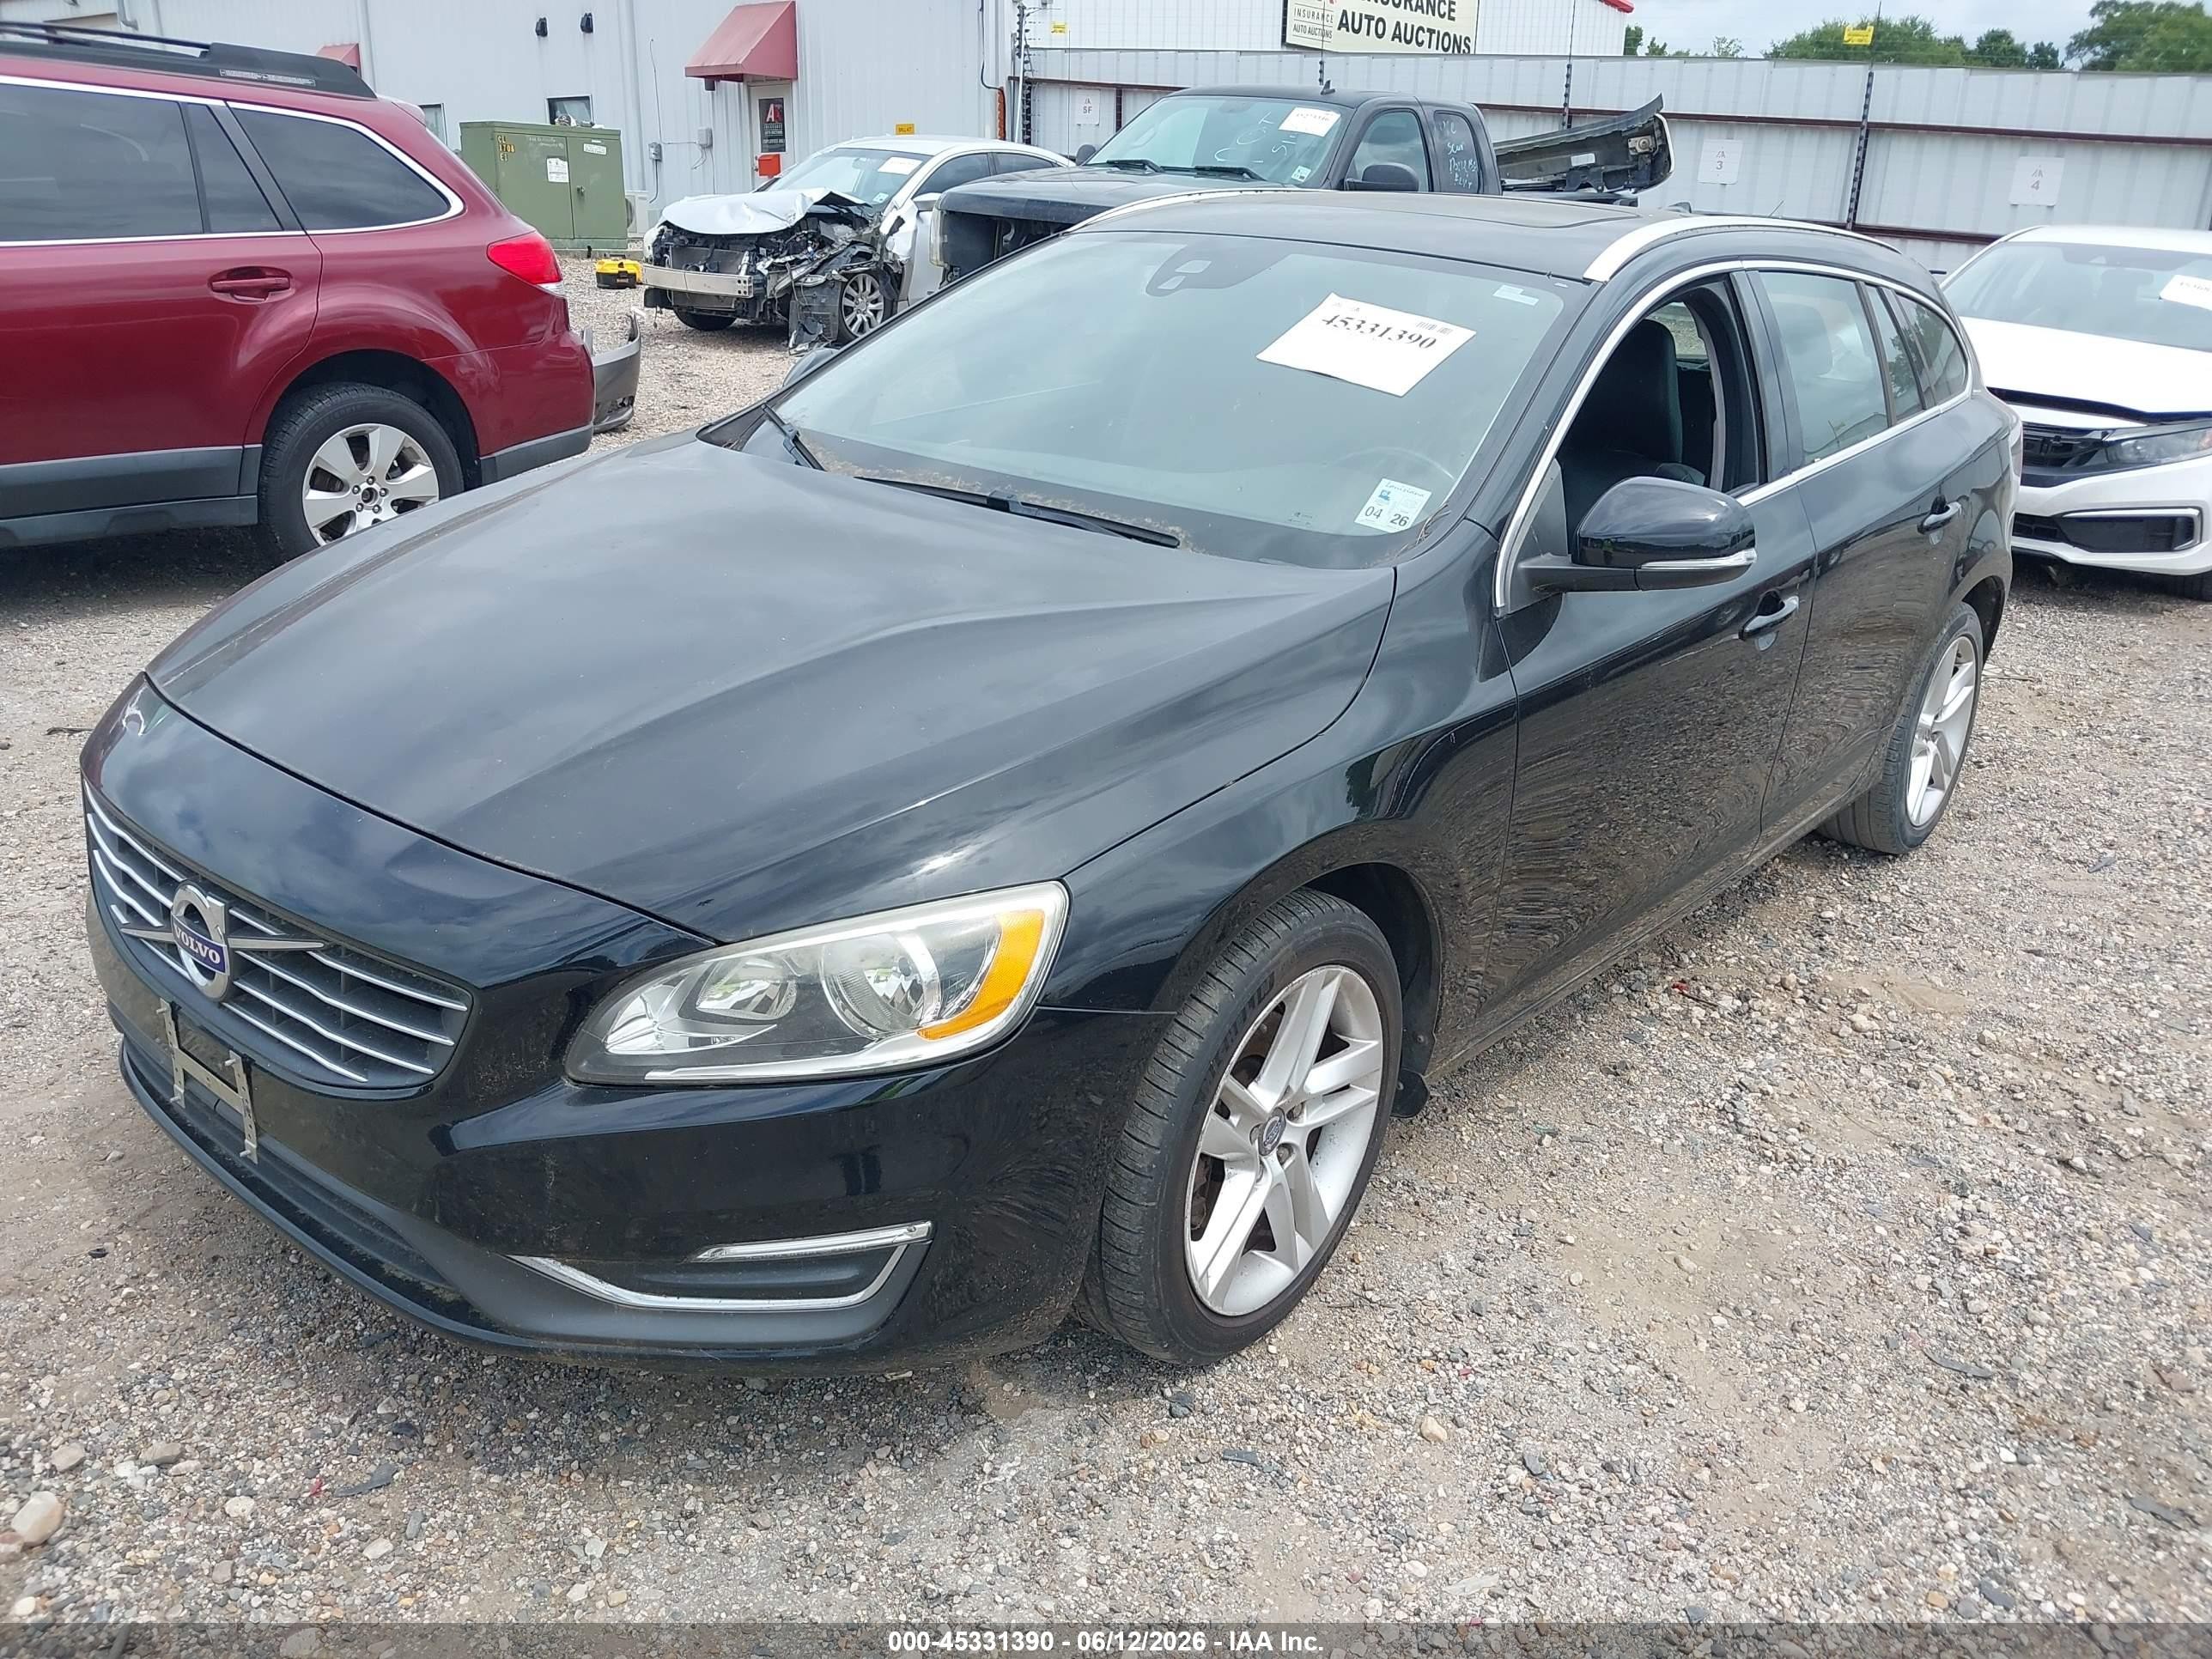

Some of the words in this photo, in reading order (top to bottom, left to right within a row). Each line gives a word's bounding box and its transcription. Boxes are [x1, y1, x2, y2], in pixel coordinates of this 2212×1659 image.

[1362, 0, 1455, 21] RANCE
[1292, 23, 1307, 34] AUTO
[1307, 26, 1333, 40] AUCTIONS
[1337, 9, 1387, 39] AUTO
[1390, 21, 1472, 54] AUCTIONS
[1716, 161, 1723, 170] 3
[2031, 179, 2040, 191] 4
[1322, 314, 1437, 349] 45331390
[1364, 506, 1383, 520] 04
[1390, 514, 1410, 527] 26
[173, 922, 221, 964] VOLVO
